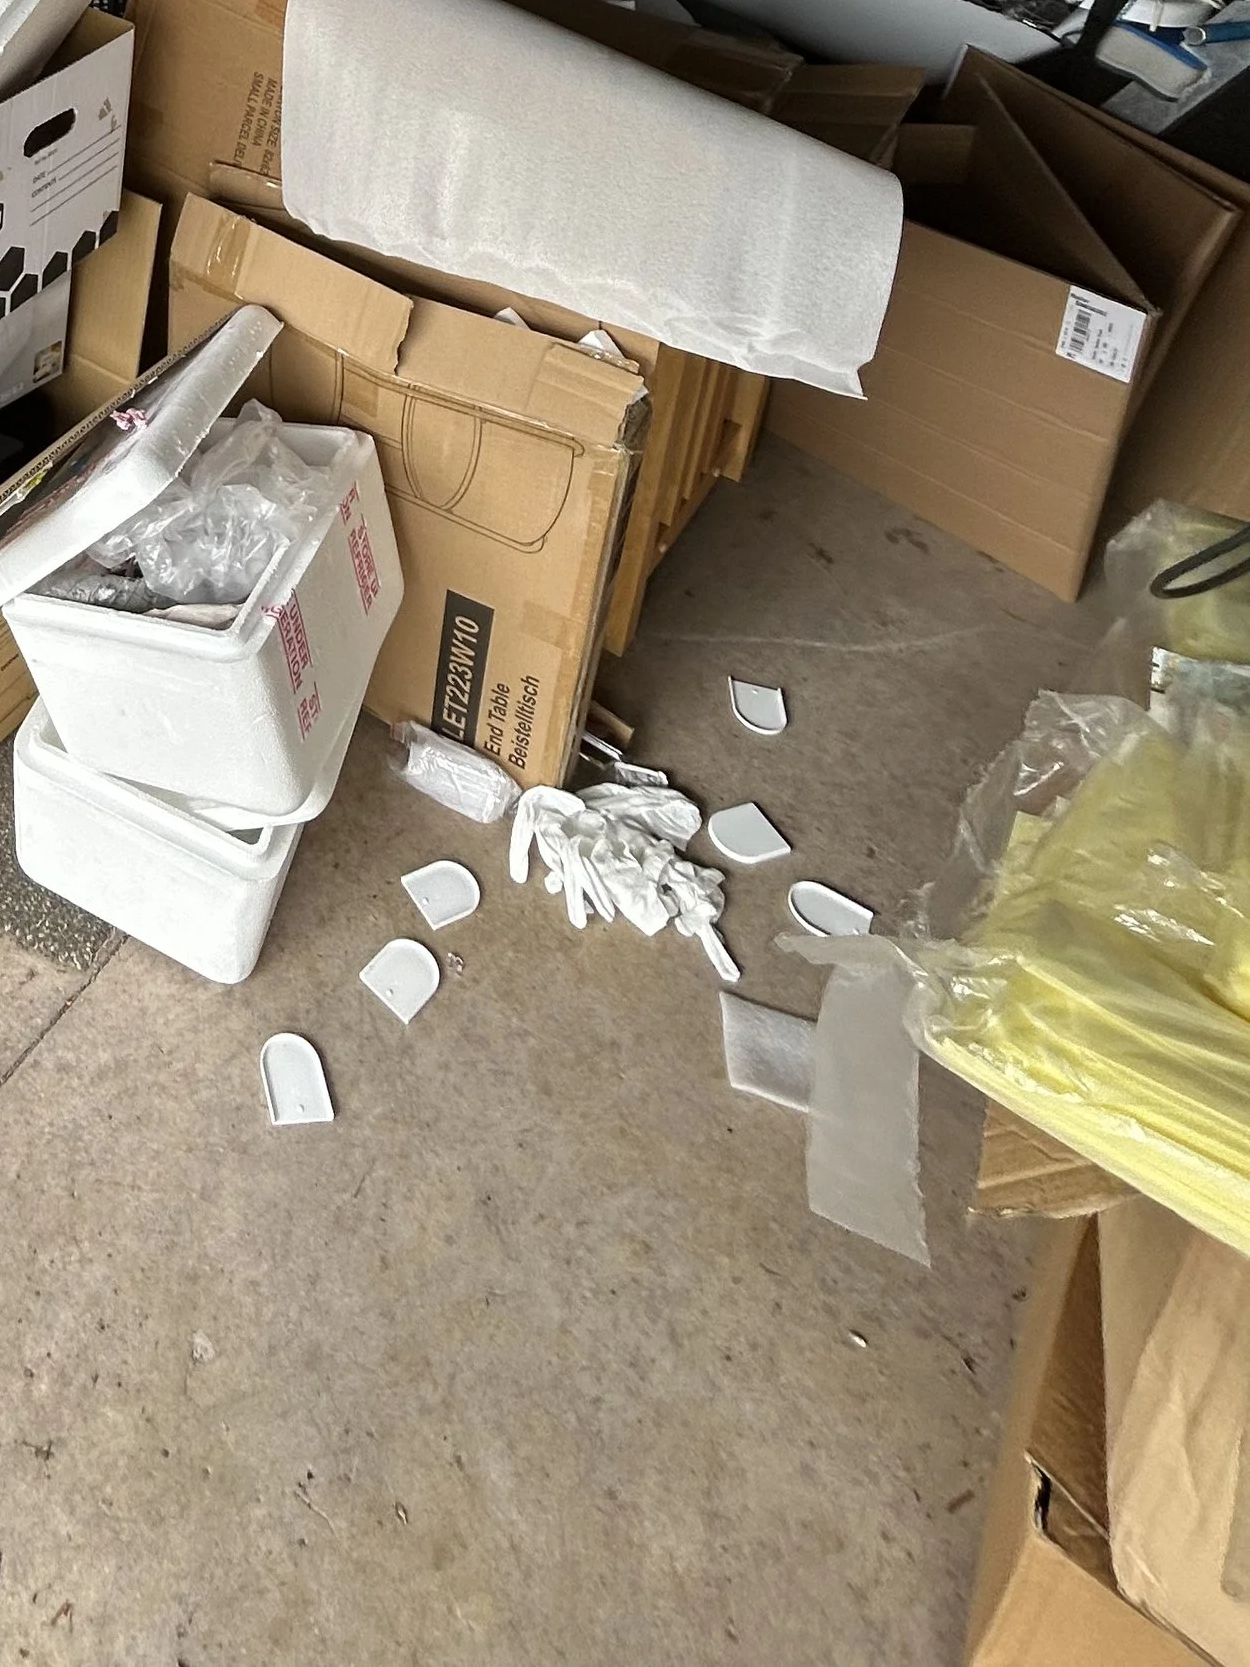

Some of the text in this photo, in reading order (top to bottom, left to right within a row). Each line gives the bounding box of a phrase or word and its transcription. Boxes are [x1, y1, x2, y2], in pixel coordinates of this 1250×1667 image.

[248, 71, 264, 104] SMALL
[252, 77, 277, 146] MADE IN CHINA
[238, 104, 254, 141] PARCEL
[289, 604, 309, 671] UNDER
[441, 615, 480, 741] LET223W10
[484, 682, 510, 756] End Table
[507, 674, 540, 770] Beistelltisch
